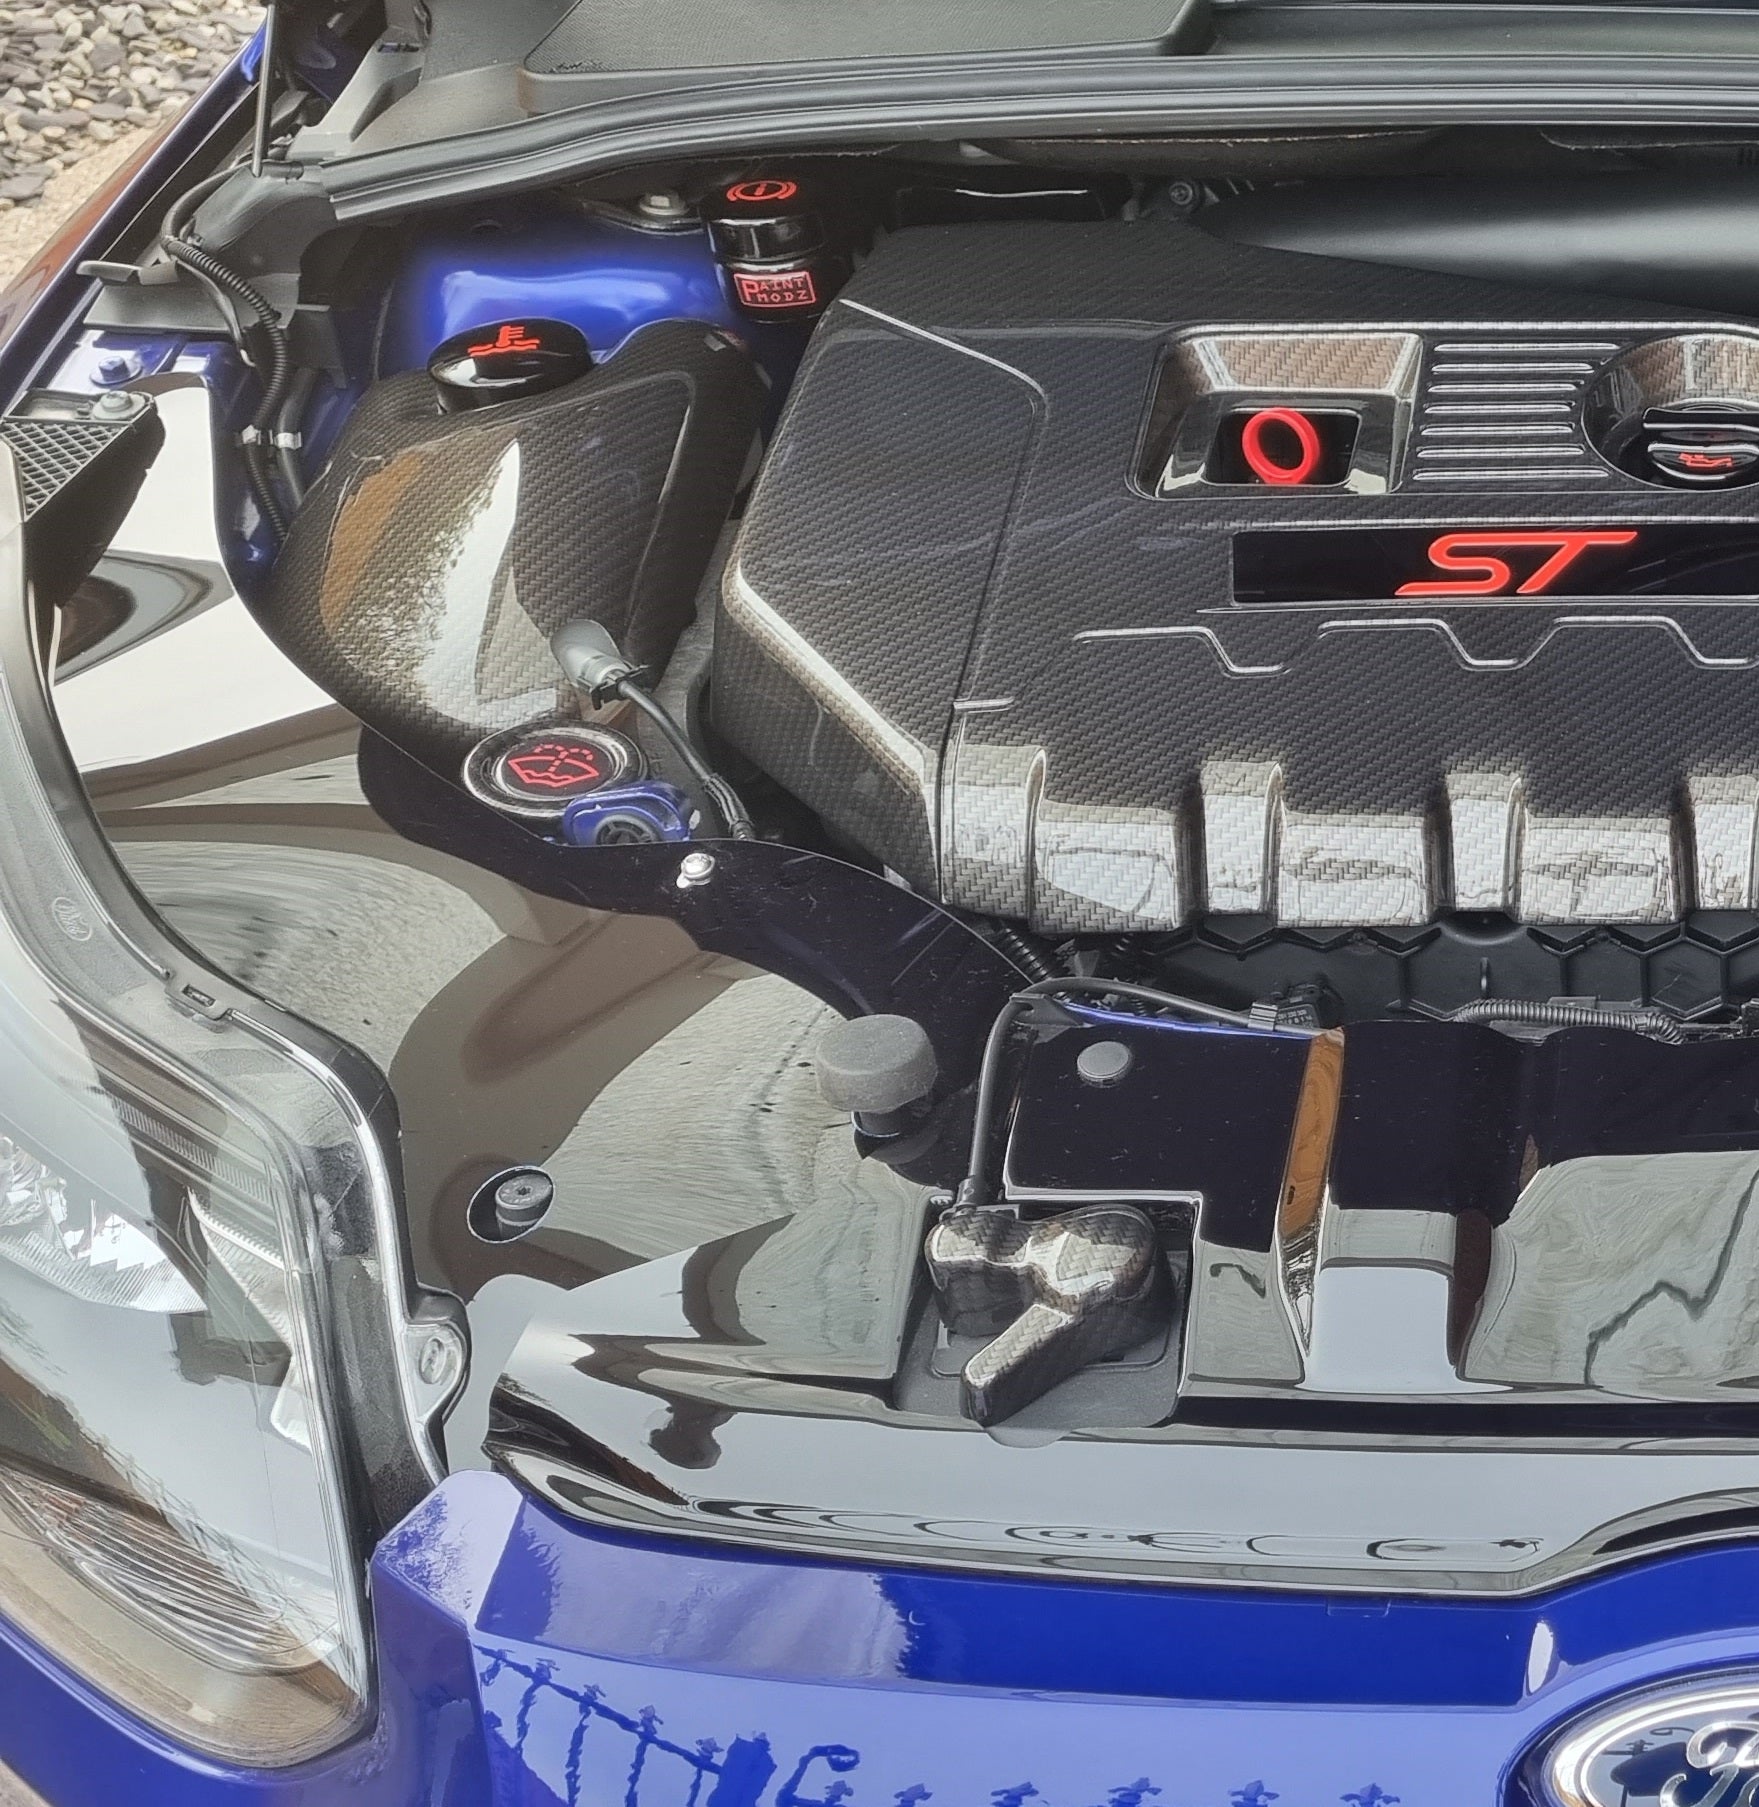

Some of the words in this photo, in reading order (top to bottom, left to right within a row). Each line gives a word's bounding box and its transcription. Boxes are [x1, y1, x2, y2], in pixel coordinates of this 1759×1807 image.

[741, 278, 803, 302] PAINT
[756, 290, 808, 302] MODZ
[1395, 532, 1638, 596] ST
